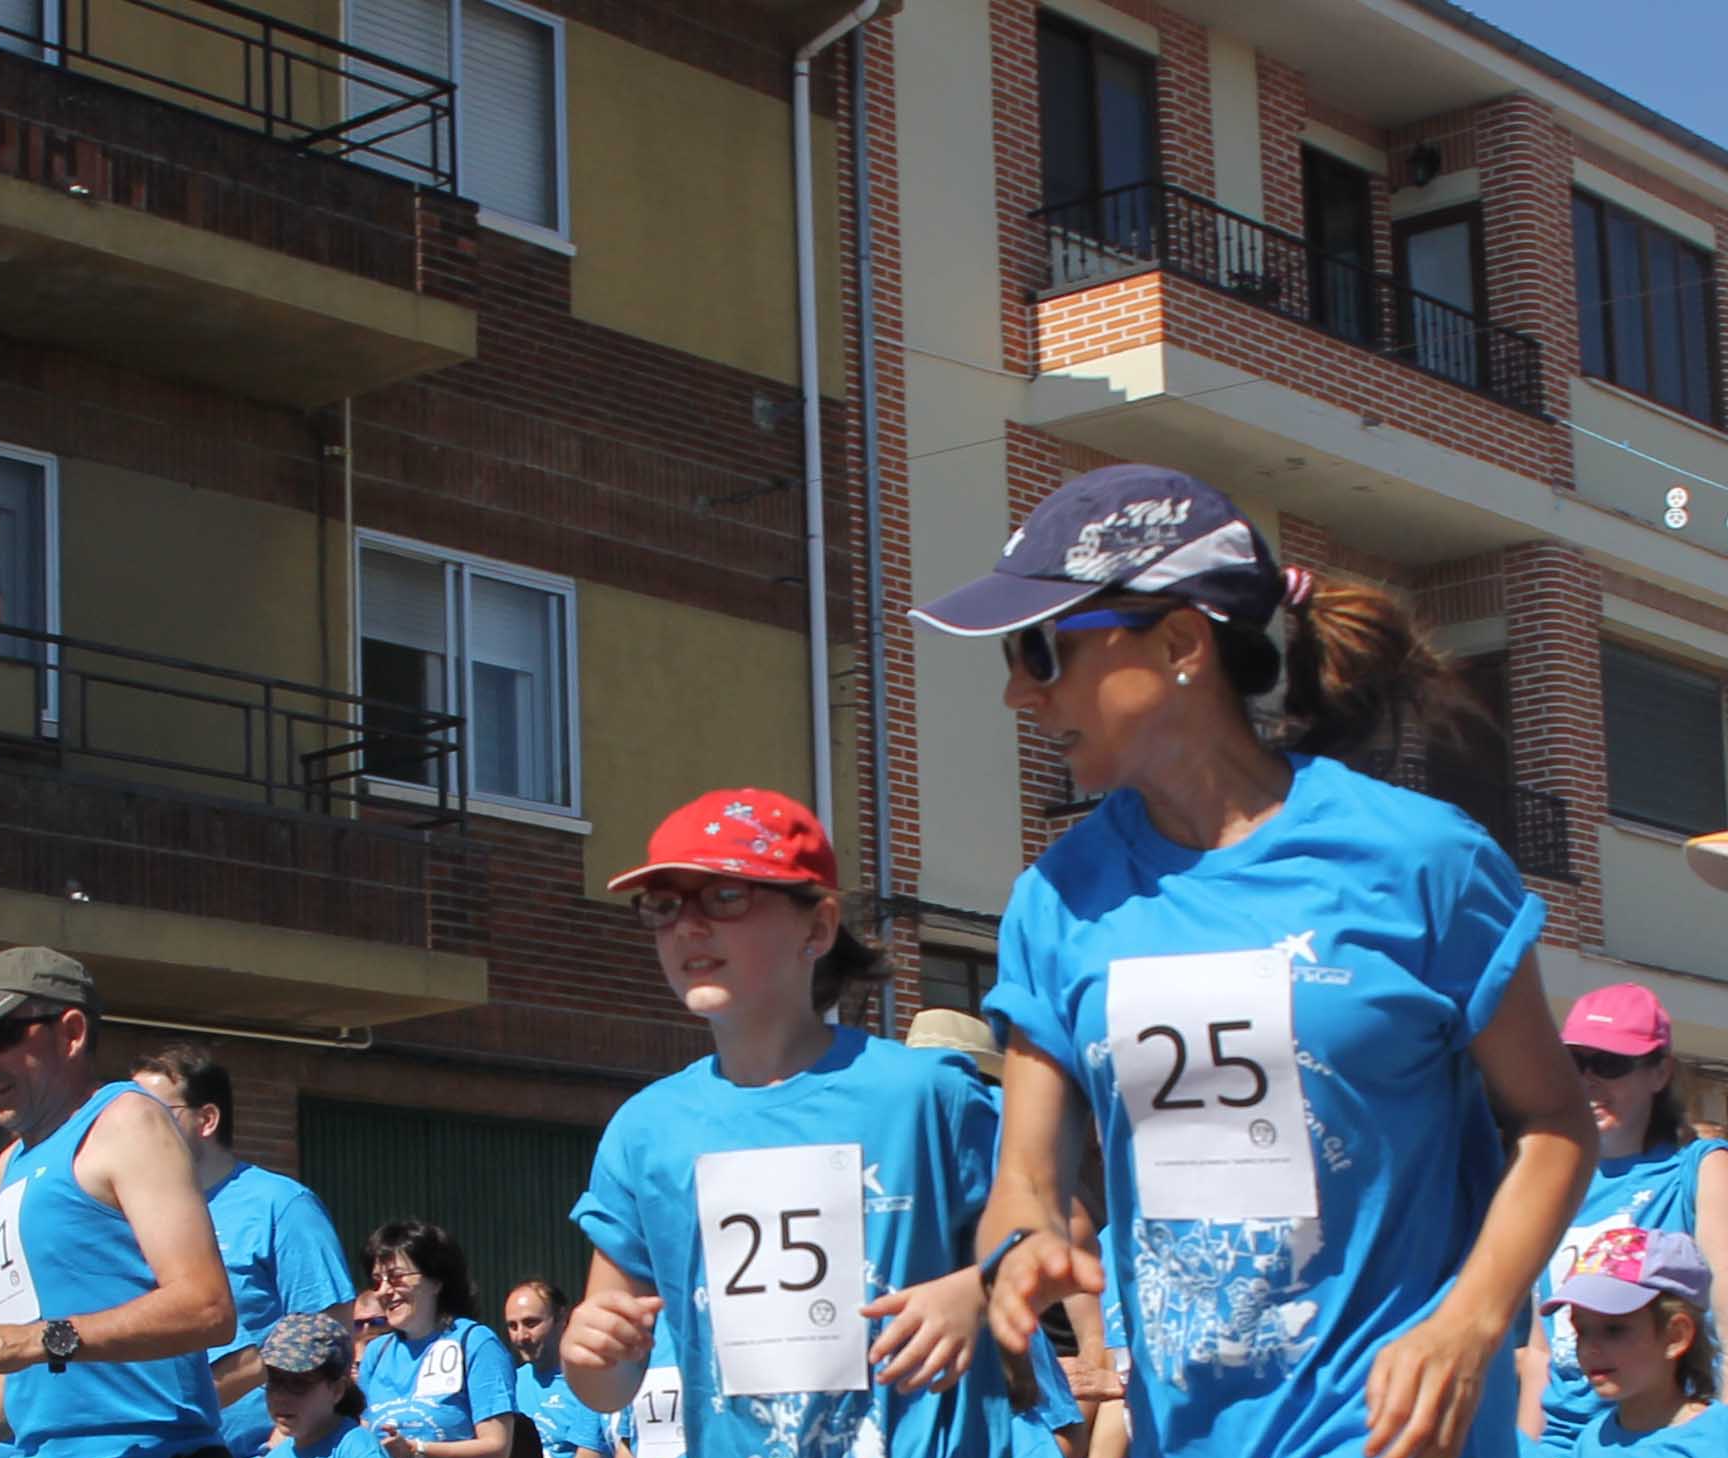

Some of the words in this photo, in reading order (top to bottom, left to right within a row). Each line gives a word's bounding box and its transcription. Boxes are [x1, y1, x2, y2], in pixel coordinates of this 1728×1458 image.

[1138, 1020, 1268, 1110] 25
[719, 1208, 828, 1296] 25
[424, 1344, 459, 1377] 10
[642, 1389, 680, 1424] 17
